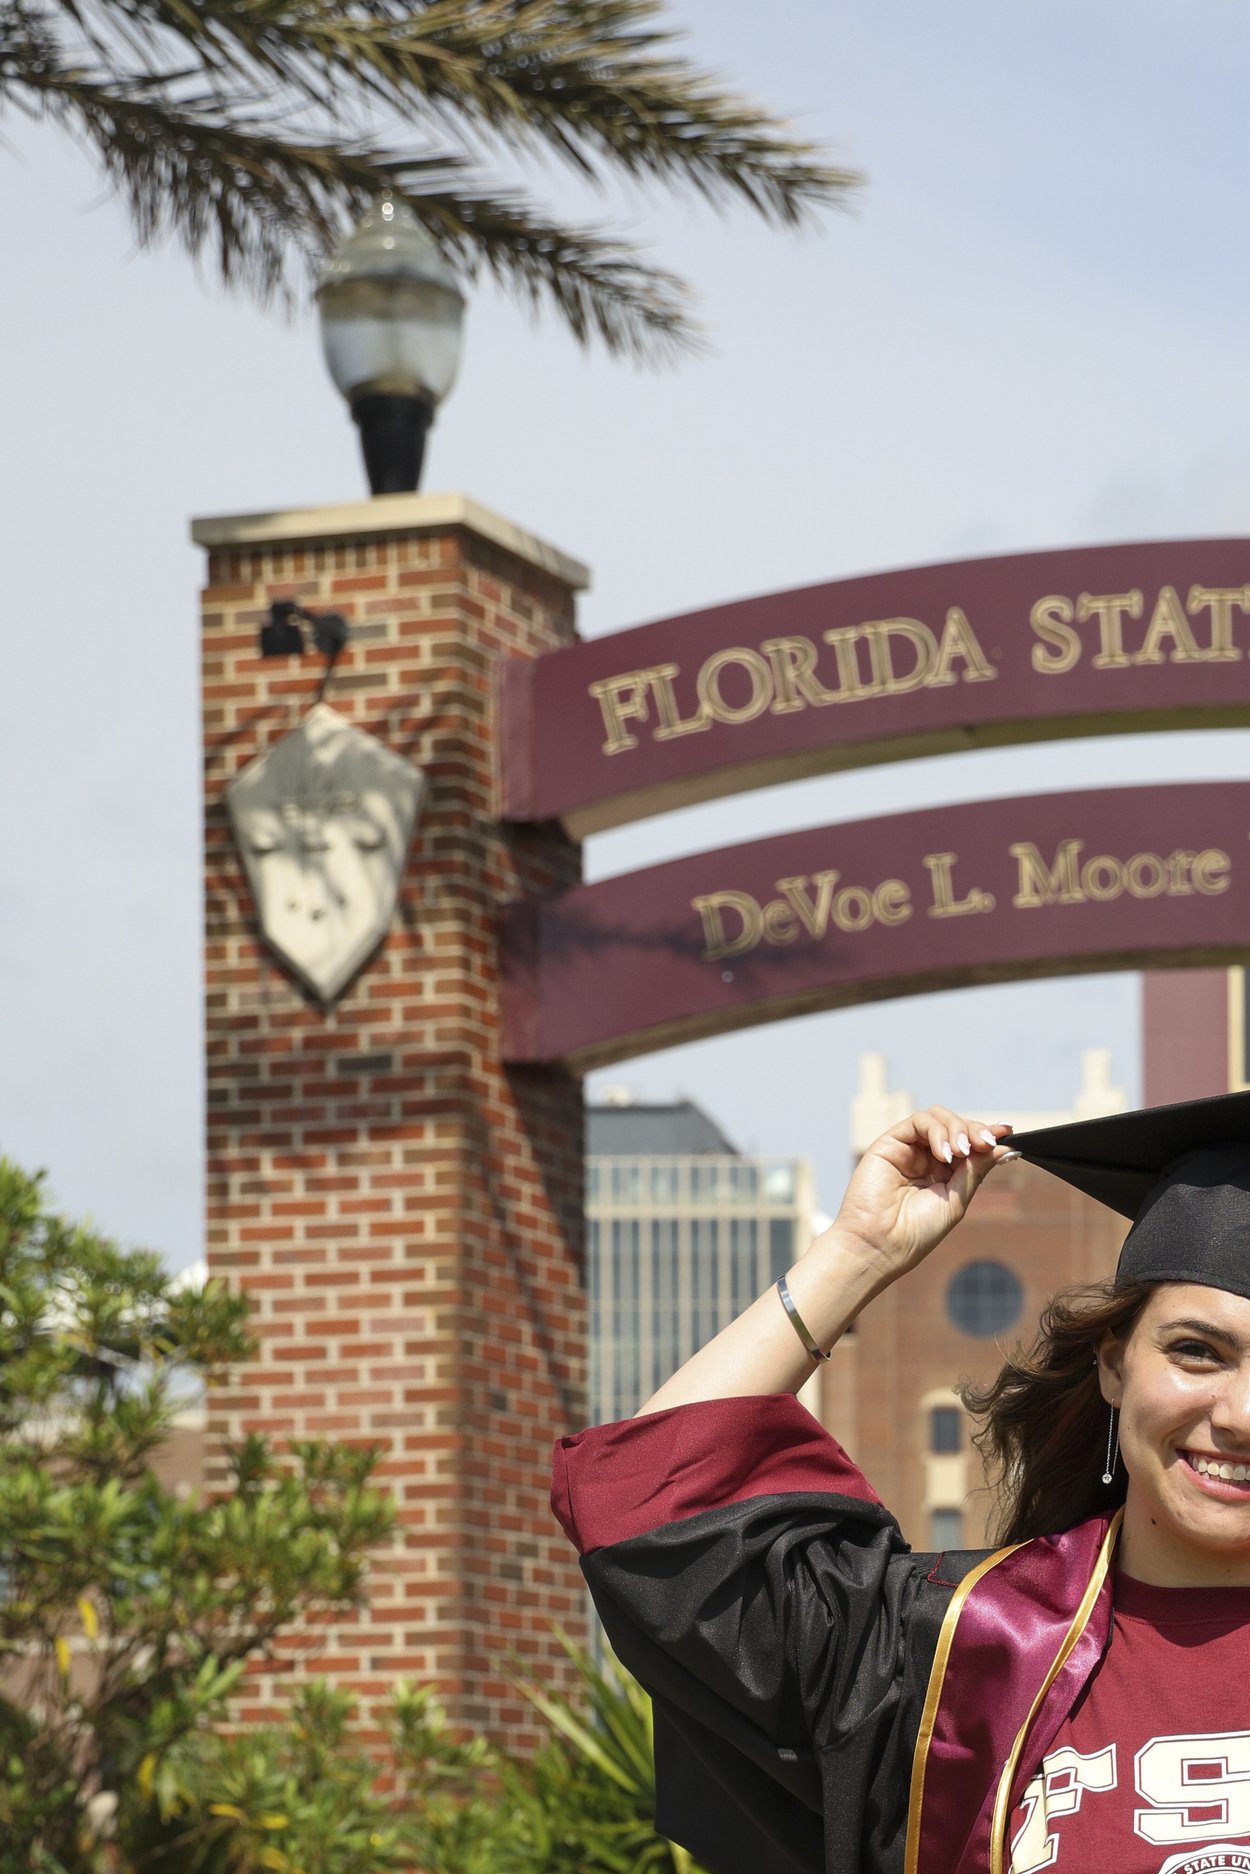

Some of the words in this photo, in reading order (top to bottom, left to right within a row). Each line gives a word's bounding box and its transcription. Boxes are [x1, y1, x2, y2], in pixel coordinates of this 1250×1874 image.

[589, 606, 998, 756] FLORIDA
[692, 870, 912, 962] DeVoe
[922, 852, 996, 919] L.
[1010, 839, 1231, 908] Moore
